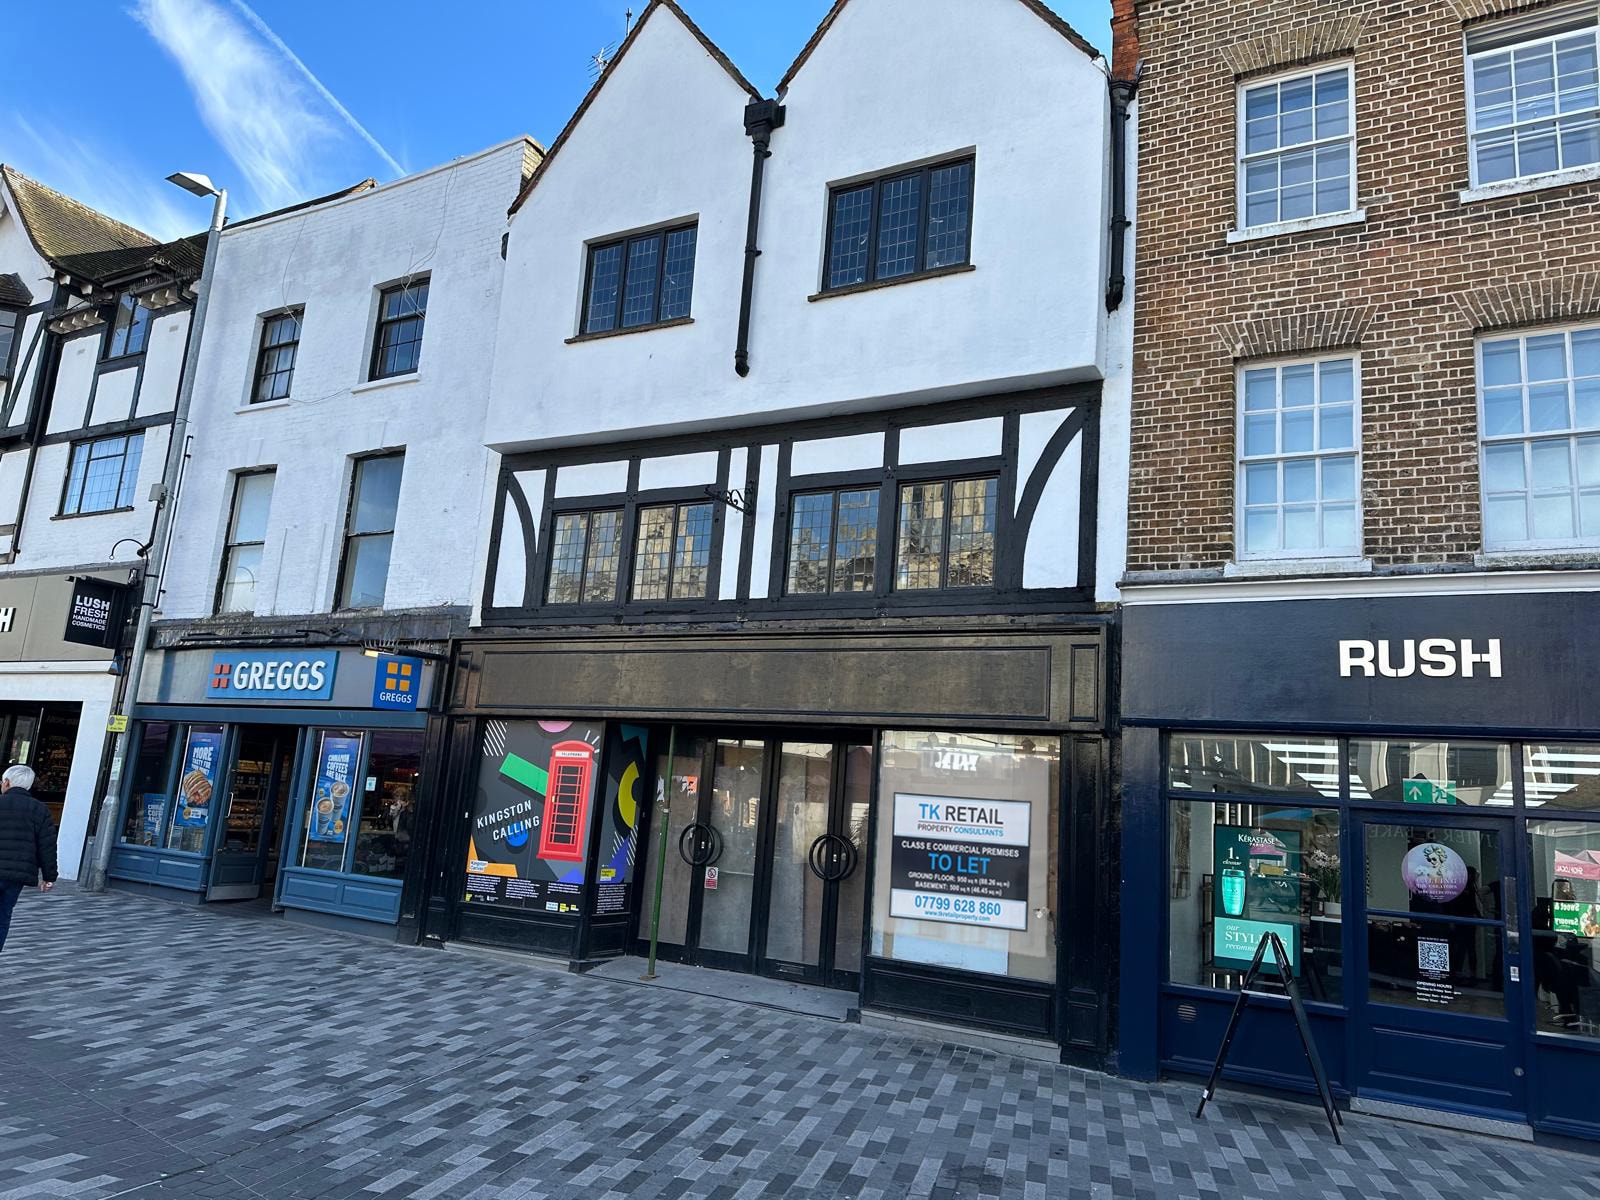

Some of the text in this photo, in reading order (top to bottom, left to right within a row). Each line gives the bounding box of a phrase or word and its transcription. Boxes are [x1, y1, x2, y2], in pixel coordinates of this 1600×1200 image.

[75, 594, 111, 611] LUSH
[72, 614, 107, 625] HANDMADE
[74, 605, 109, 620] FRESH
[71, 620, 106, 631] COSMETICS
[1339, 638, 1502, 678] RUSH
[233, 661, 326, 691] GREGGS
[379, 691, 413, 704] GREGGS
[192, 746, 214, 762] MORE
[477, 800, 532, 829] KINGSTON
[918, 803, 1004, 825] TK RETAIL
[492, 815, 540, 841] CALLING
[917, 823, 1004, 837] PROPERTY CONSULTANTS
[901, 840, 1019, 858] CLASS E COMMERCIAL PREMISES
[1227, 847, 1239, 860] 1.
[928, 853, 991, 875] TO LET
[908, 871, 933, 880] GROUND
[934, 873, 956, 882] FLOOR:
[915, 881, 949, 890] BASEMENT:
[914, 895, 1001, 916] 07799 628 860
[924, 910, 991, 921] www.tkretailproperty.com
